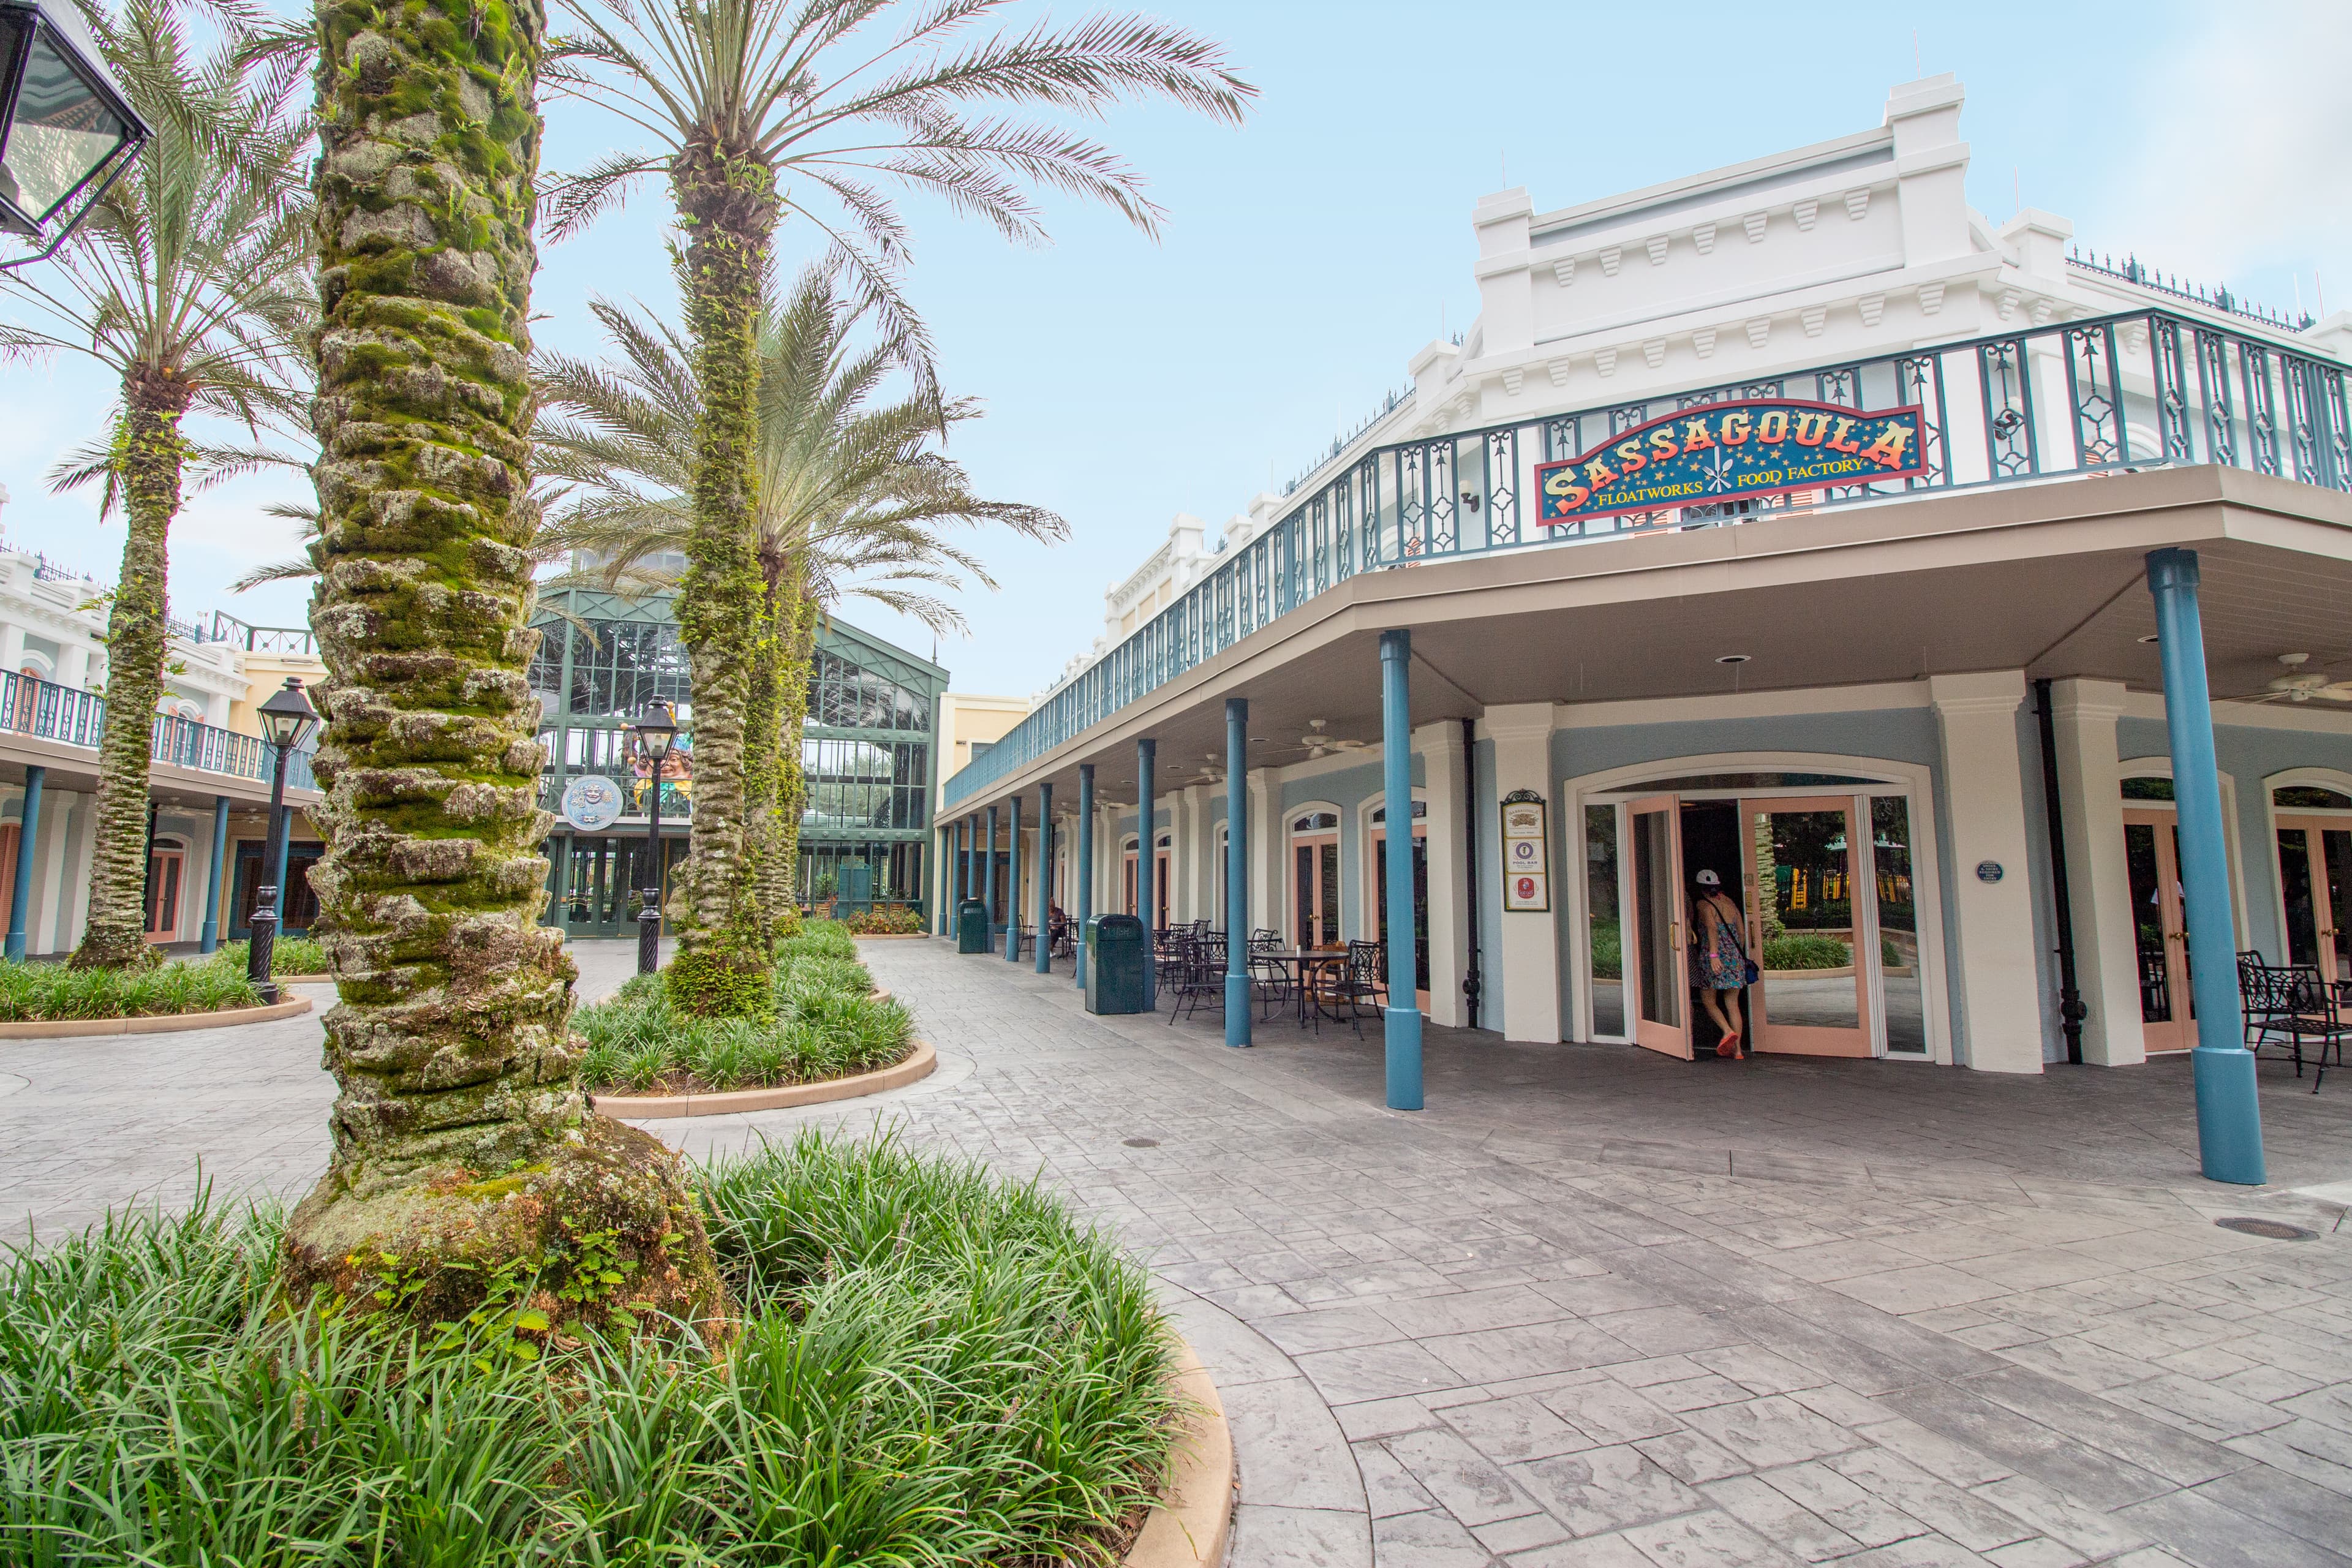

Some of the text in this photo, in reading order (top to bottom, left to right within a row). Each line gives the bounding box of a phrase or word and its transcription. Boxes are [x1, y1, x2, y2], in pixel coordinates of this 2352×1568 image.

[1545, 410, 1915, 515] SASSAGOULA
[1737, 458, 1864, 488] FOOD FACTORY
[1598, 481, 1703, 507] FLOATWORKS
